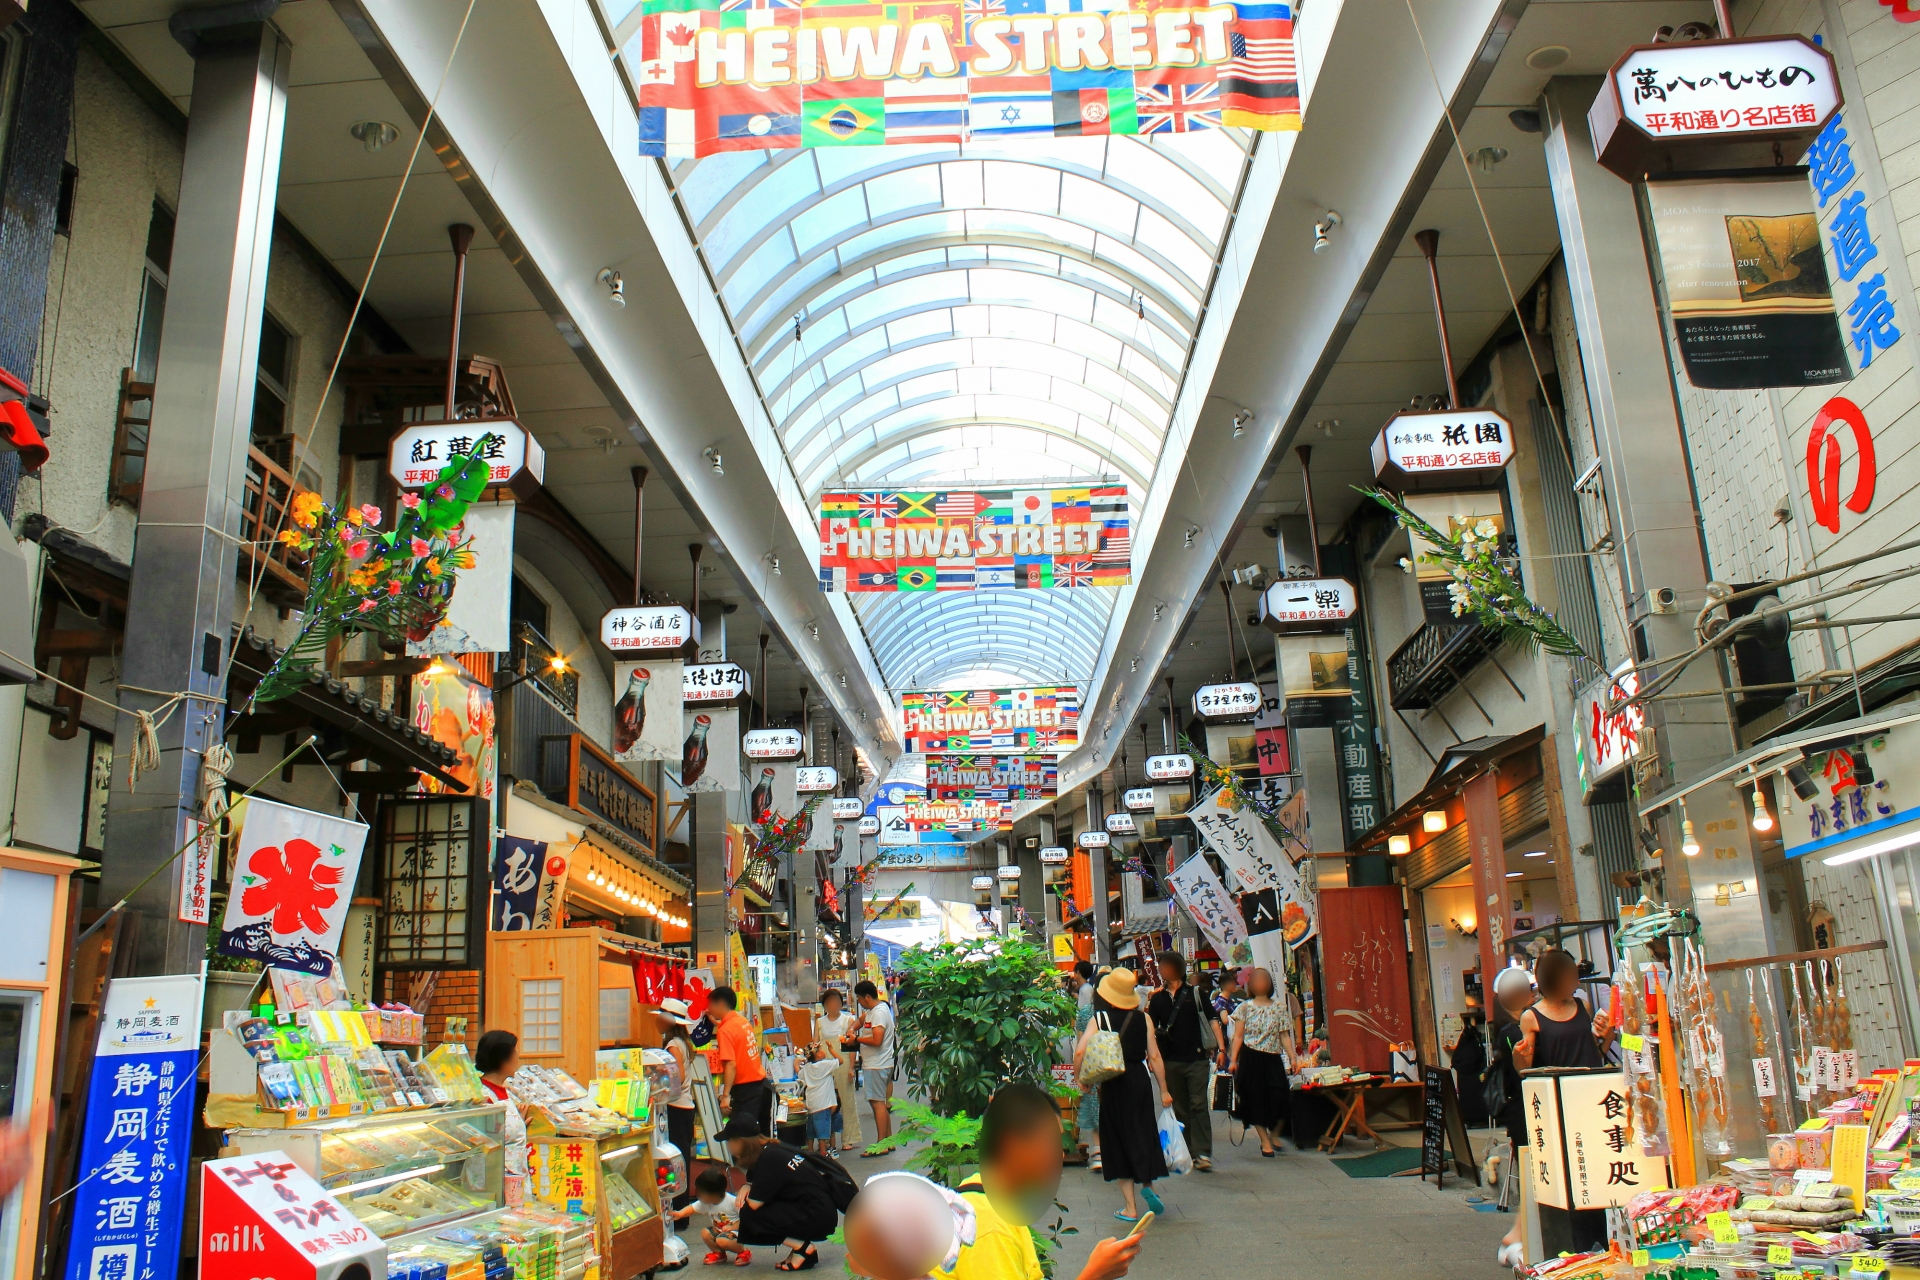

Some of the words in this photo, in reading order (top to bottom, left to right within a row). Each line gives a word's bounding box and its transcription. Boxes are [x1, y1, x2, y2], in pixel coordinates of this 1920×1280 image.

[699, 24, 955, 85] HEIWA
[969, 8, 1236, 74] STREET
[1631, 66, 1815, 105] 萬八のひもの
[1645, 103, 1817, 132] 平和通り名店街
[1692, 205, 1729, 215] Museum
[1737, 258, 1761, 268] 2017
[1401, 451, 1501, 469] 平和通り名店街
[404, 465, 510, 484] 平和店街
[847, 526, 969, 558] HEIWA
[977, 523, 1103, 556] STREET
[611, 615, 682, 633] 神谷酒店
[1279, 609, 1346, 620] 平和通り名店街
[610, 636, 682, 648] 平和通り名店街
[918, 712, 988, 732] HEIWA
[989, 708, 1064, 729] STREET
[1205, 705, 1255, 715] 平和通り名店街
[937, 771, 991, 786] HEIWA
[992, 770, 1046, 785] STREET
[914, 806, 958, 819] HEIWA
[958, 806, 1003, 819] STREET
[116, 1015, 180, 1030] 静岡麦酒
[96, 1062, 158, 1231] 静岡麦酒
[1531, 1091, 1550, 1186] 食事処
[1597, 1089, 1640, 1186] 食事処
[221, 1160, 297, 1187] コーヒー
[273, 1199, 340, 1230] ランチ
[209, 1225, 265, 1252] milk
